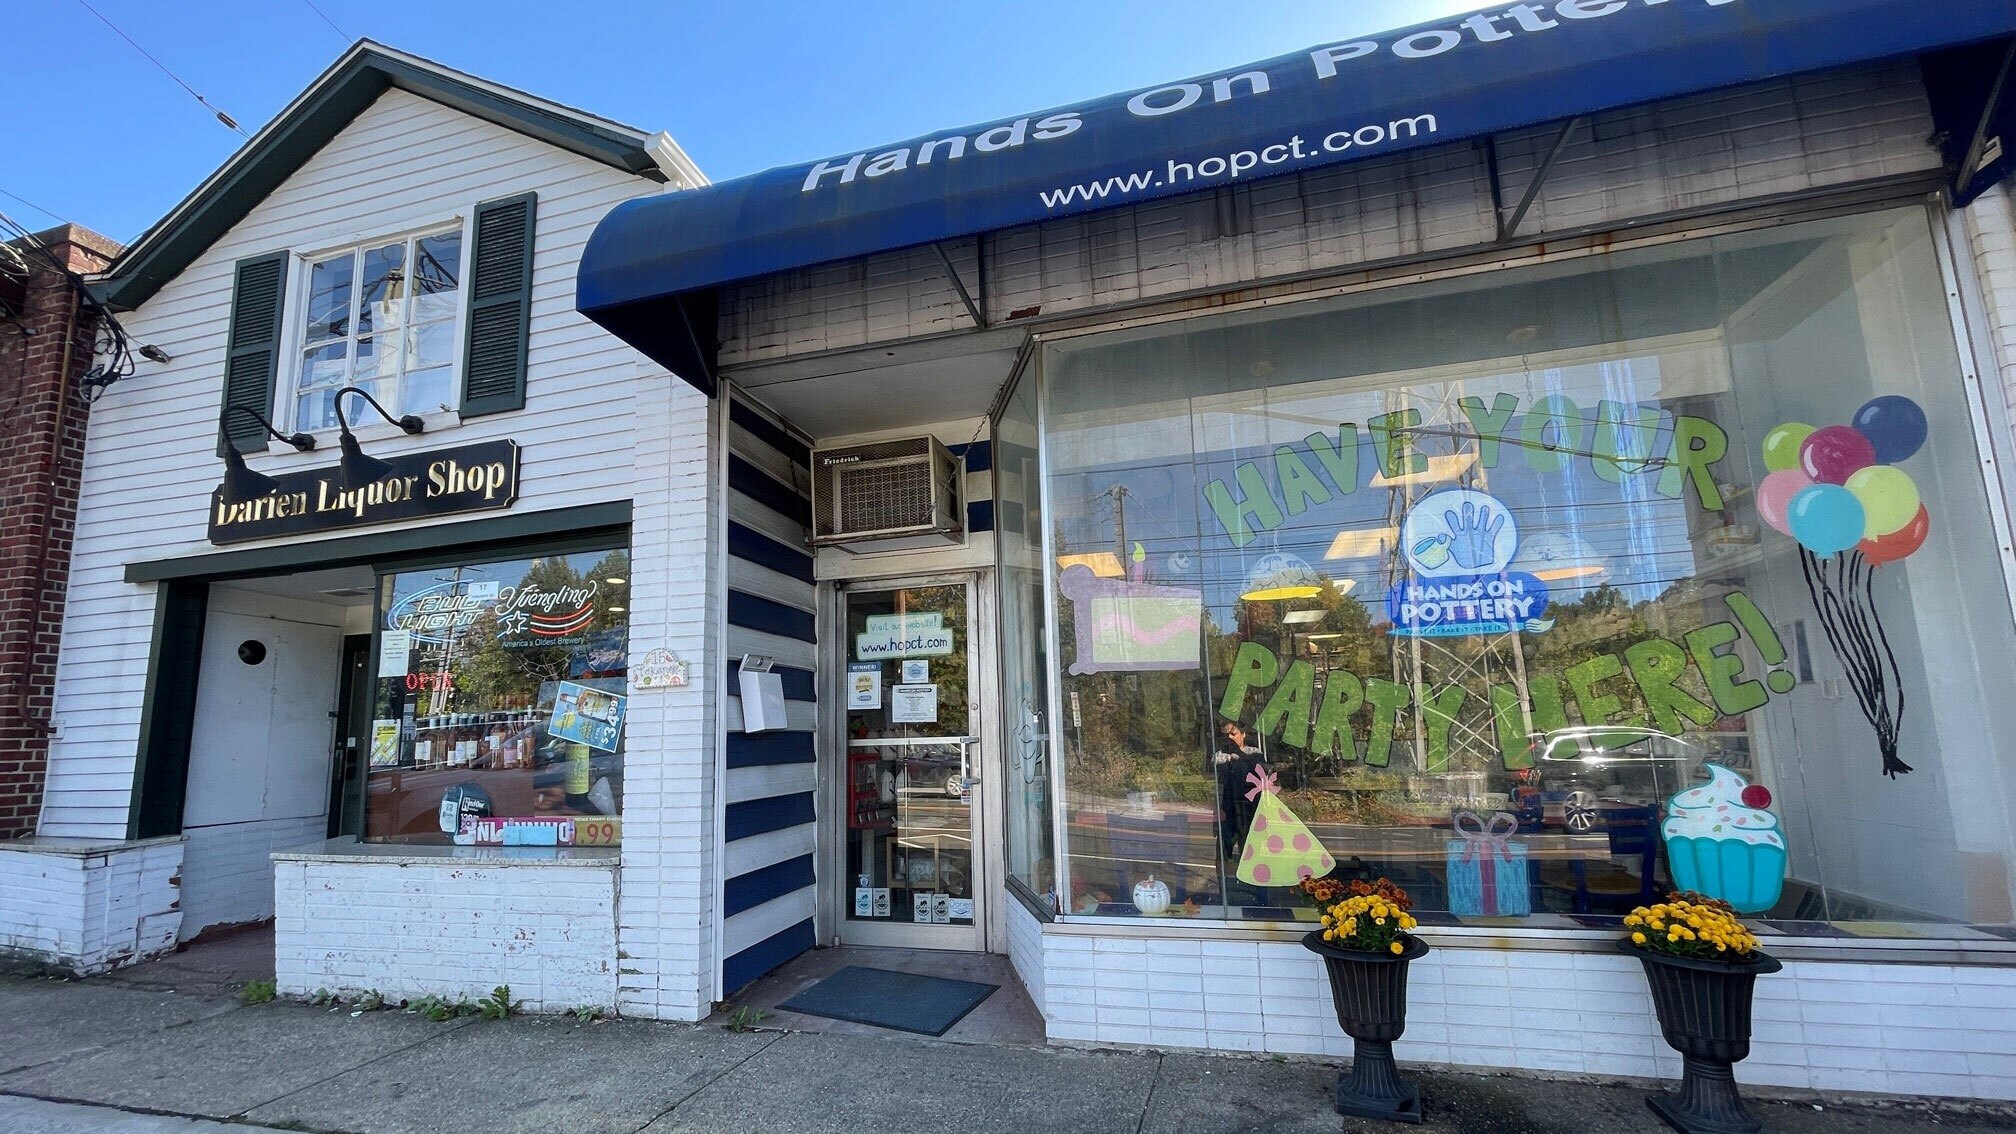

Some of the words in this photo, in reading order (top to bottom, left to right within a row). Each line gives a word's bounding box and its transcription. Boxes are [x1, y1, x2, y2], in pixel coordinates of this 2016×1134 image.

[800, 113, 1083, 192] Hands
[1127, 71, 1272, 117] On
[1310, 0, 1735, 80] Potte
[1040, 113, 1437, 208] www.hopct.com
[823, 455, 860, 465] Friedrich
[1202, 408, 1429, 549] HAVE
[1457, 392, 1729, 512] YOUR
[315, 474, 419, 518] Liquor
[426, 460, 506, 501] Shop
[479, 583, 488, 591] 17
[1407, 582, 1484, 601] HANDS
[1487, 580, 1524, 597] ON
[418, 595, 482, 613] BUD
[1401, 596, 1534, 624] POTTERY
[400, 610, 485, 631] LIGHT
[870, 622, 889, 632] Visit
[535, 637, 557, 647] Oldest
[557, 637, 585, 647] Brewery
[861, 635, 948, 655] www.hopct.com
[1219, 641, 1468, 773] PARTY
[1490, 591, 1796, 771] HERE!
